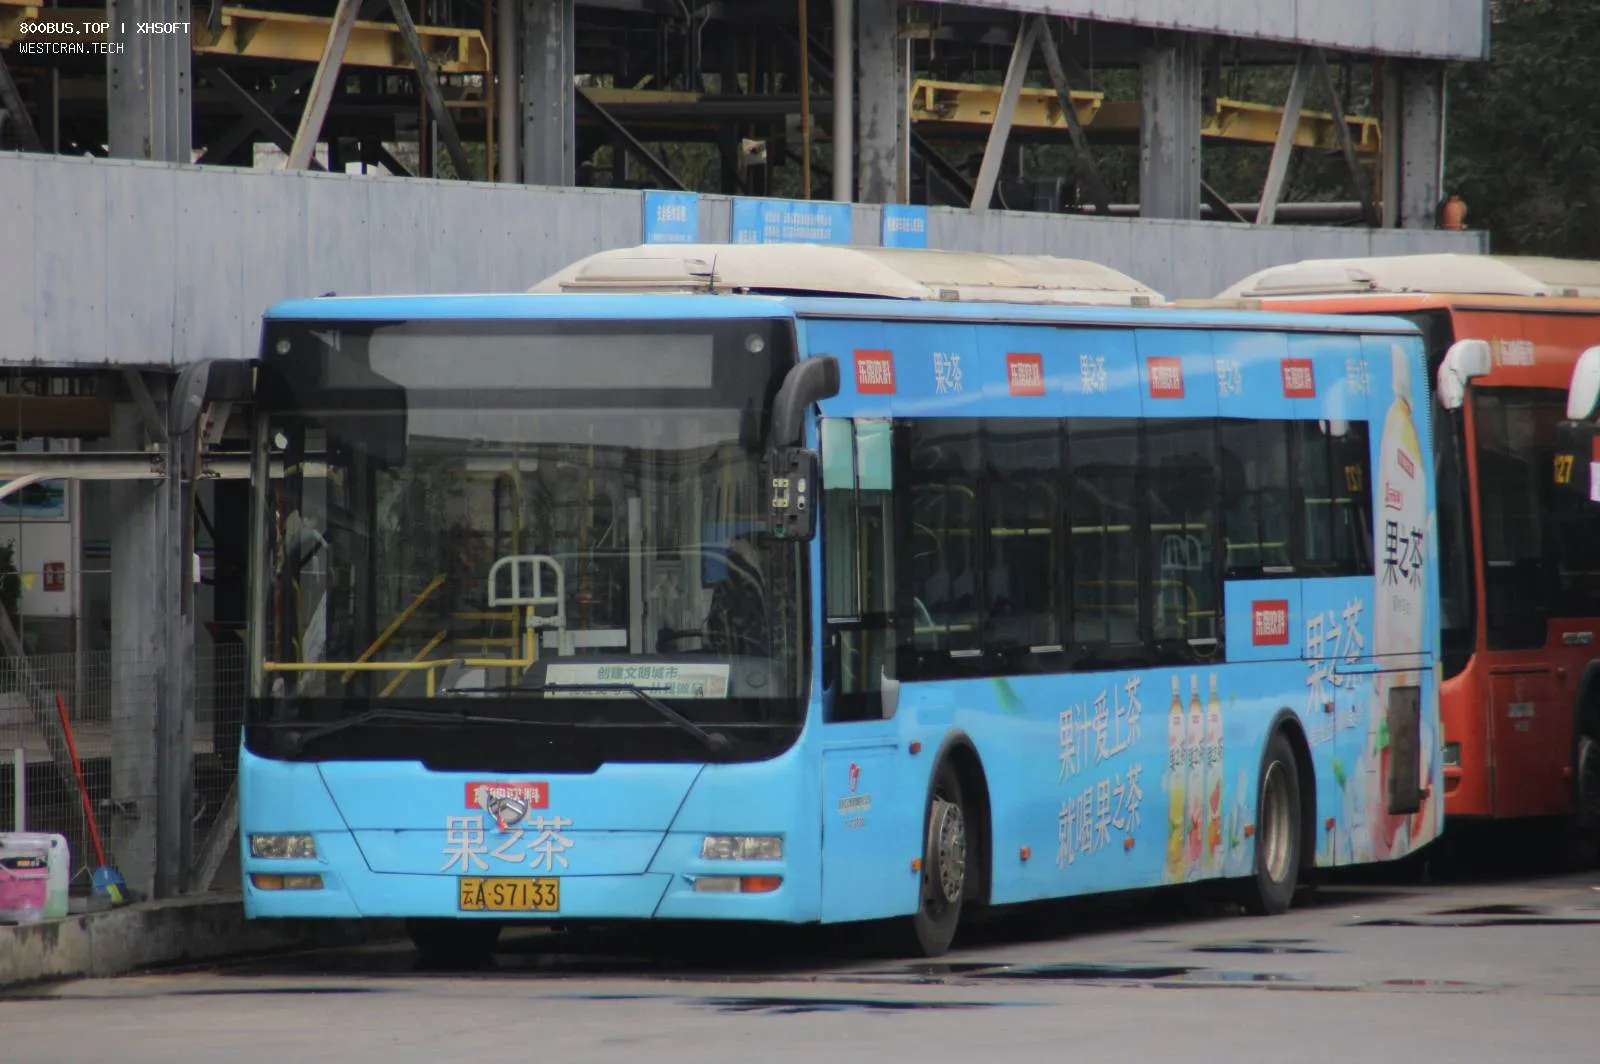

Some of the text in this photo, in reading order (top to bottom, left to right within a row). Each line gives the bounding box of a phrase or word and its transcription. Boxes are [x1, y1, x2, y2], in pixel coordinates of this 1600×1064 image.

[932, 351, 963, 394] 果之茶
[1381, 519, 1424, 590] 果之茶
[596, 665, 680, 681] 创建文明城市
[1305, 595, 1365, 717] 果之茶
[1057, 673, 1143, 784] 果汁爱上茶
[439, 814, 576, 873] 果之茶
[1055, 761, 1144, 871] 就喝果之茶
